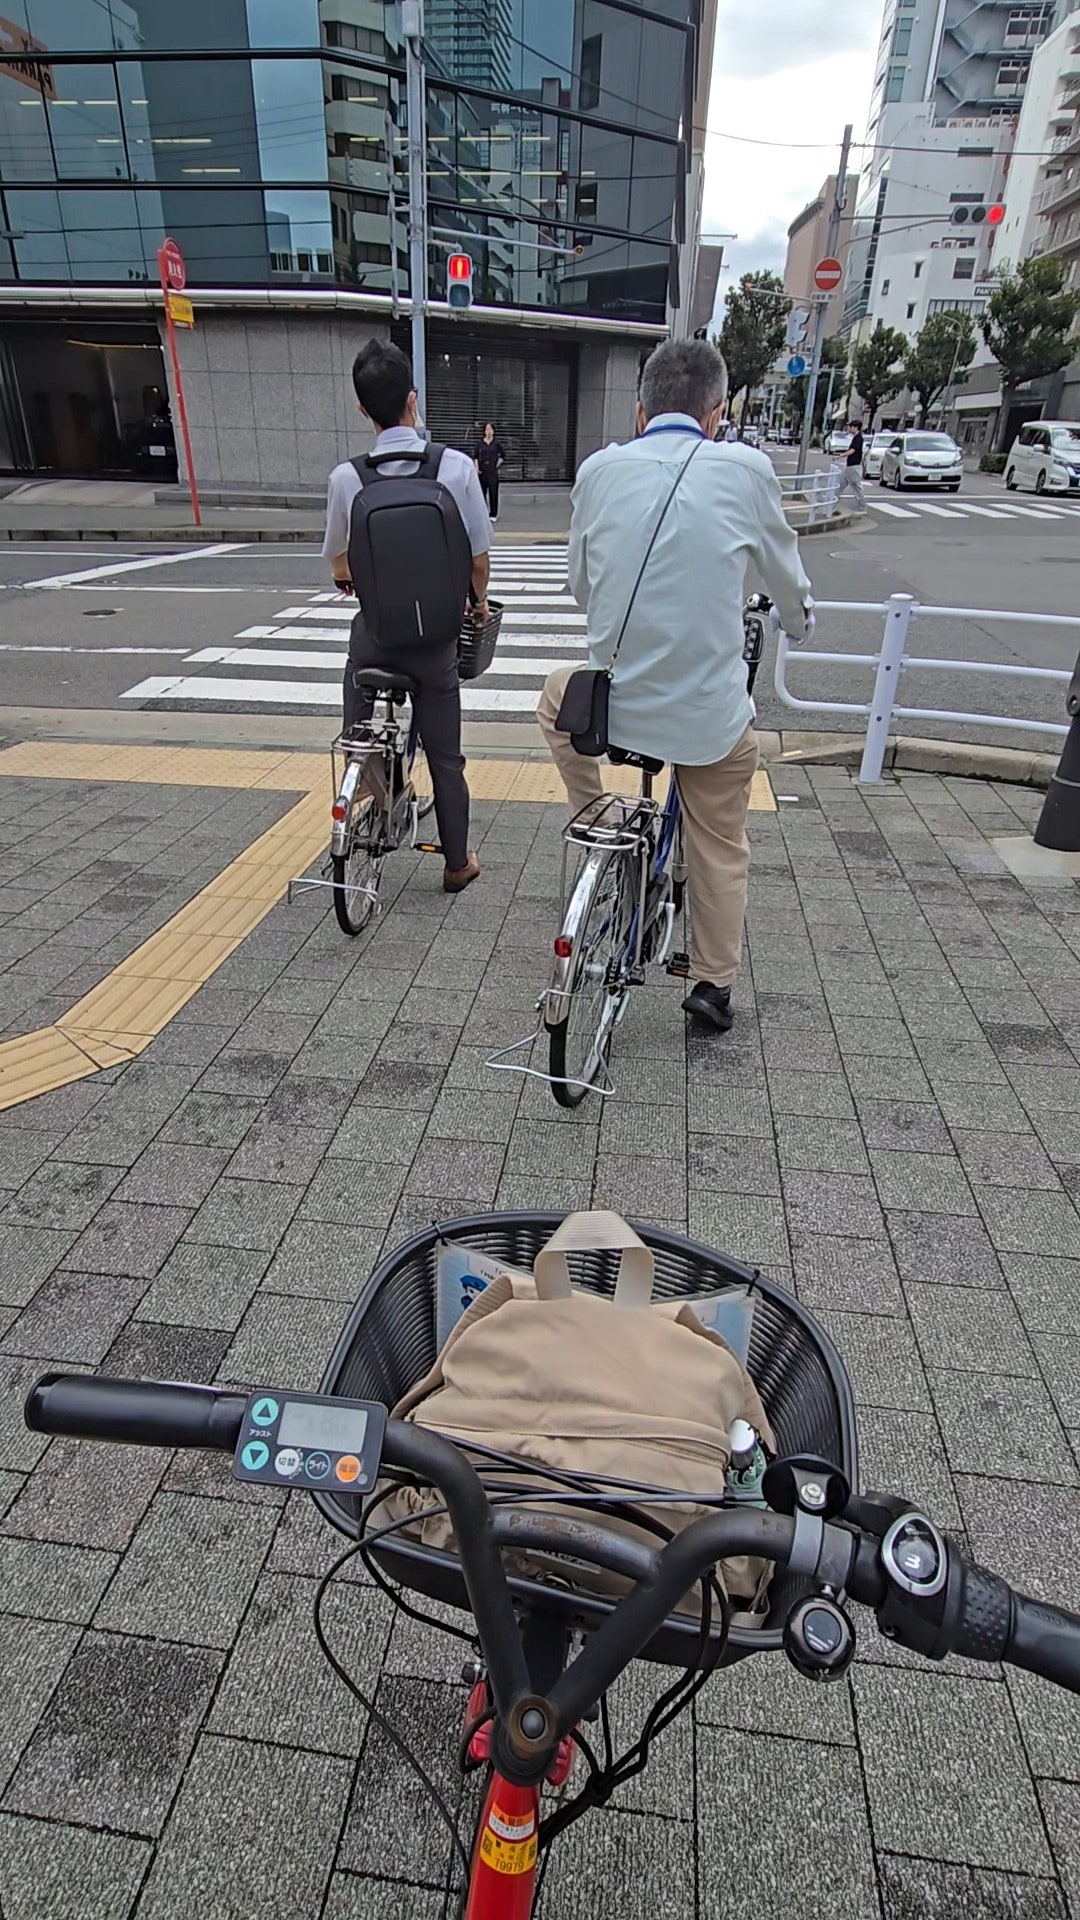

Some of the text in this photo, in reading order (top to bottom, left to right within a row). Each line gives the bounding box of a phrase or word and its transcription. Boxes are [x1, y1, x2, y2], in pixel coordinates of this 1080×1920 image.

[248, 1428, 272, 1438] アシスト
[308, 1459, 328, 1471] ライト
